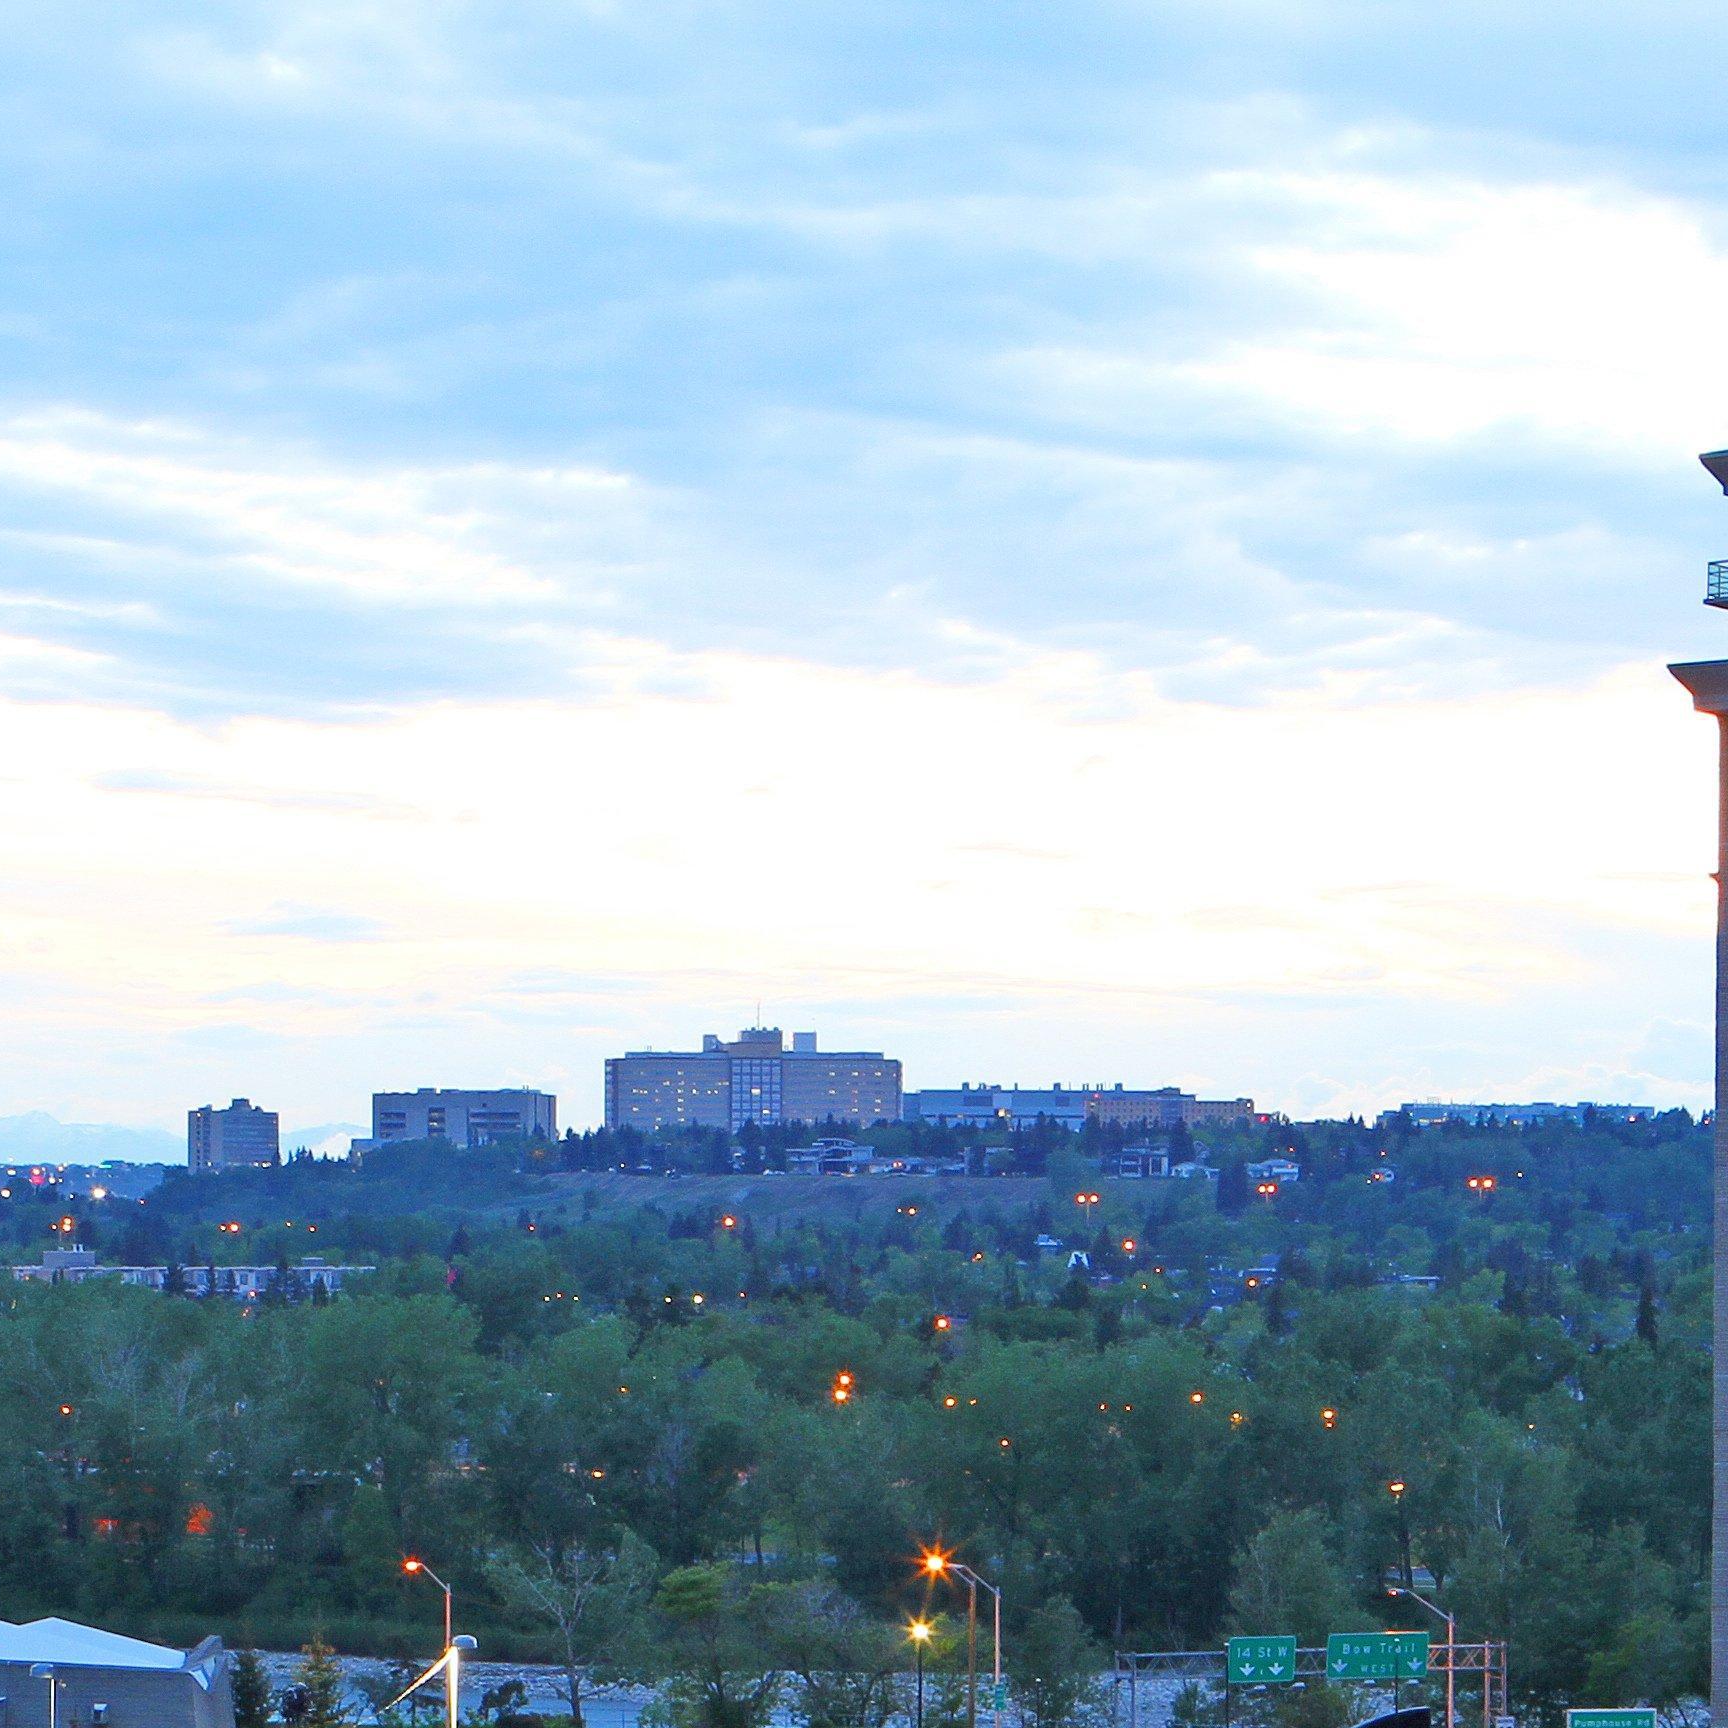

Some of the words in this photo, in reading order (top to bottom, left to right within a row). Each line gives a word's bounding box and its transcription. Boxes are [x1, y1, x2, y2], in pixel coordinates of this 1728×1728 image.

[1237, 1647, 1251, 1658] 14
[1258, 1646, 1271, 1658] St
[1277, 1646, 1288, 1657] W
[1342, 1643, 1371, 1655] Bow
[1380, 1642, 1415, 1655] Trail
[1361, 1663, 1396, 1673] WEST
